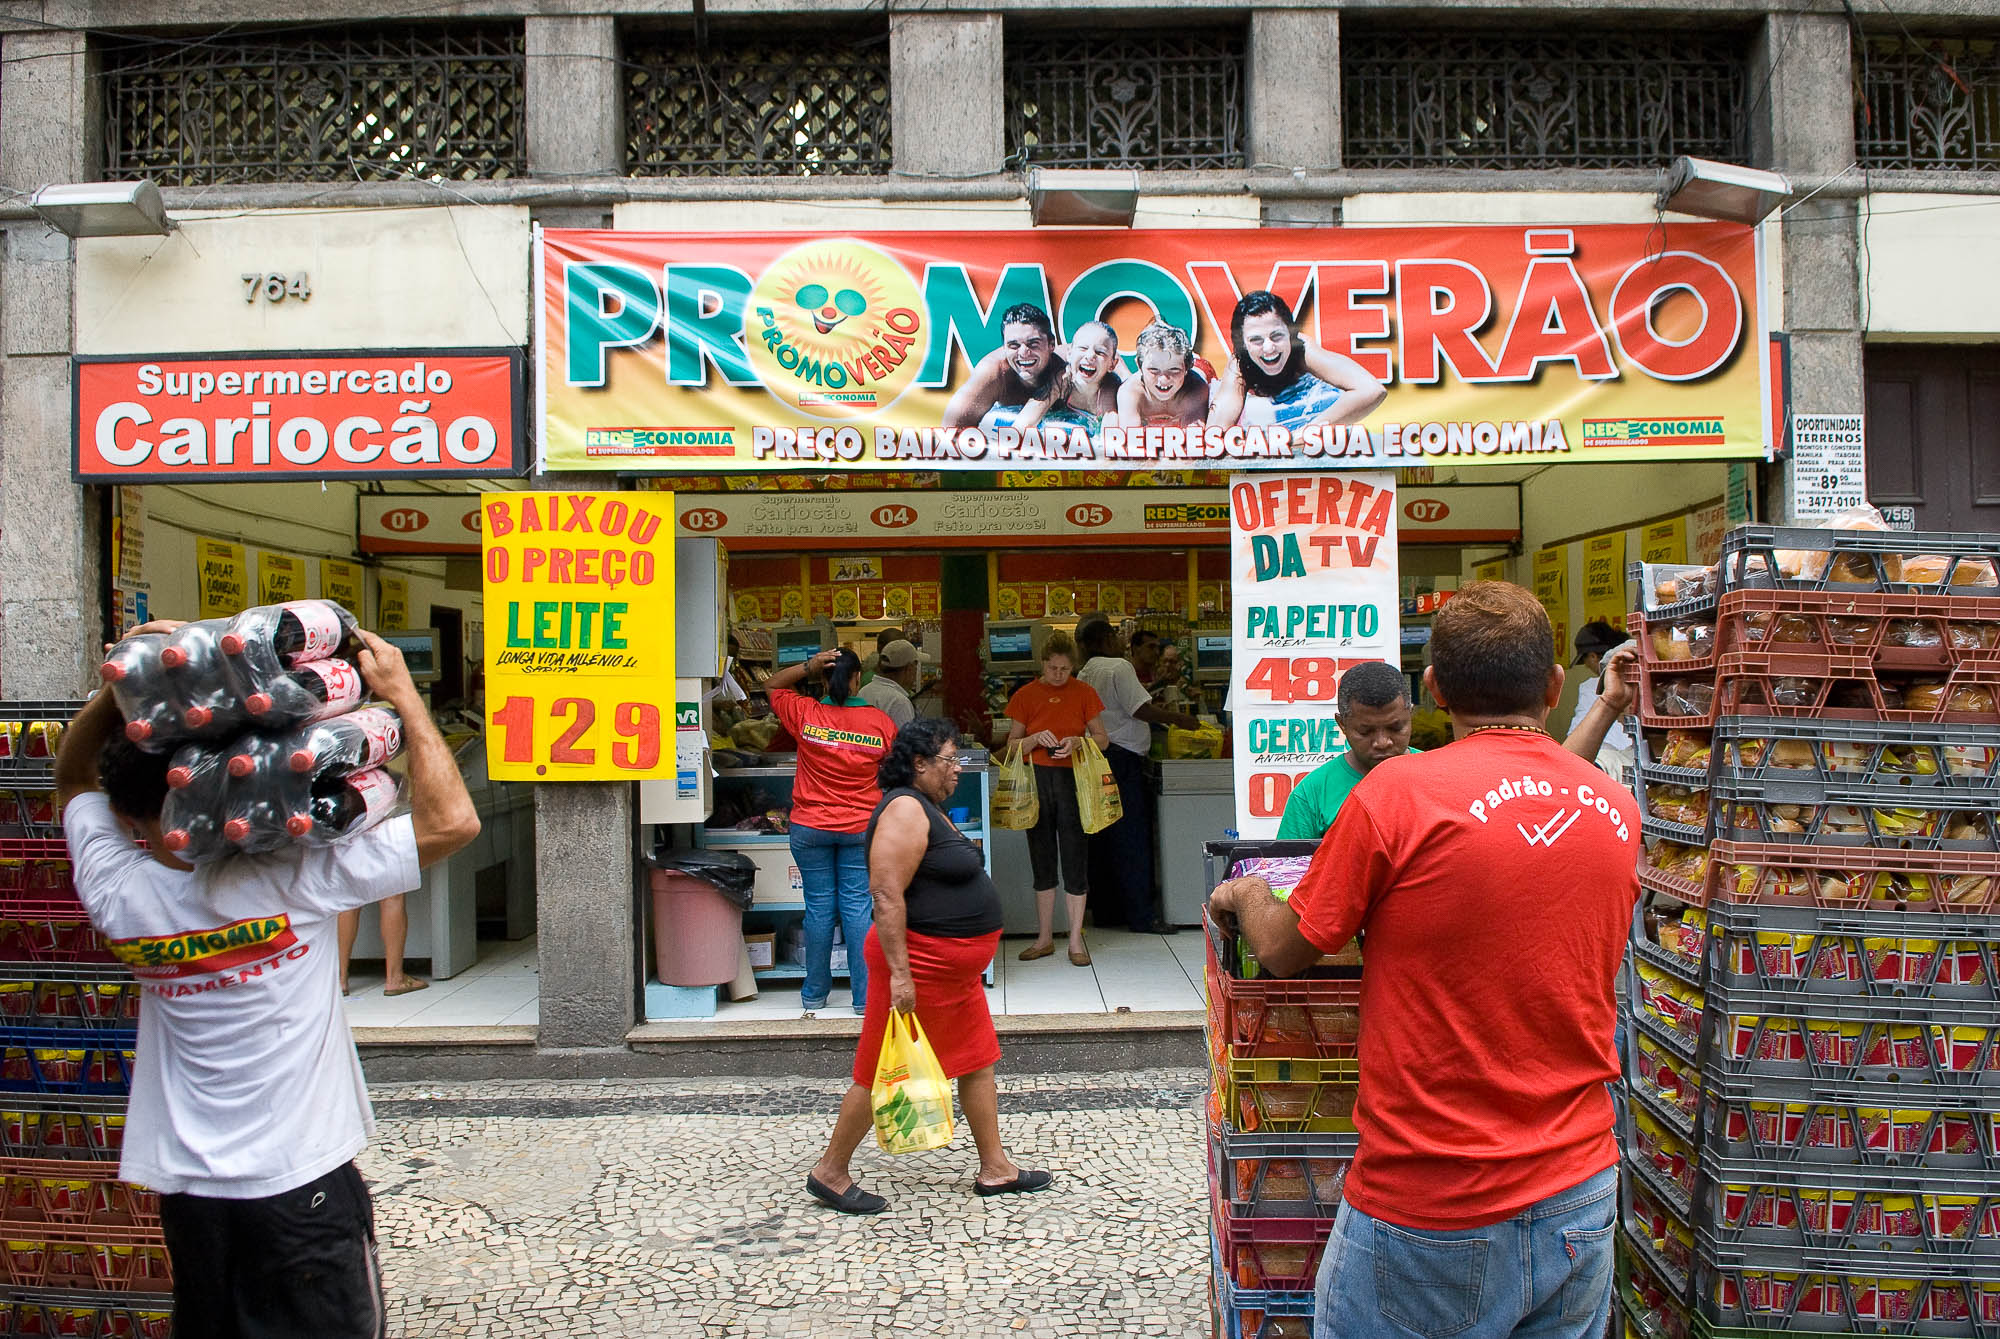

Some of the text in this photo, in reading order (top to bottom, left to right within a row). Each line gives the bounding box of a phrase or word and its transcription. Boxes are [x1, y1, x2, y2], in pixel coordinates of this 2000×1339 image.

[241, 271, 311, 302] 764
[756, 307, 920, 389] PROMOVERÃO
[137, 362, 453, 402] Supermercado
[1796, 418, 1861, 431] OPORTUNIDADE
[94, 400, 498, 467] Cariocão
[752, 419, 1571, 465] PREÇO BAIXO PARA REFRESCAR SUA ECONOMIA
[1797, 434, 1861, 443] TERRENOS
[1821, 475, 1838, 489] 89
[752, 504, 852, 521] Cariocão
[943, 502, 1040, 518] Cariocão
[1074, 507, 1104, 523] 05
[1232, 477, 1393, 537] OFERTA
[1412, 502, 1441, 519] 07
[1883, 509, 1911, 521] 756
[391, 512, 419, 529] 01
[486, 495, 661, 545] BAIXOU
[688, 511, 718, 529] 03
[879, 508, 909, 524] 04
[744, 523, 782, 534] Feito
[787, 524, 813, 535] pra
[935, 520, 972, 532] Feito
[977, 522, 1002, 534] pra
[1251, 533, 1379, 582] DA TV
[487, 547, 655, 591] O PREÇO
[507, 601, 628, 650] LEITE
[496, 651, 535, 666] LONGA
[538, 651, 565, 666] VIDA
[1248, 719, 1352, 753] CERVE
[1469, 776, 1553, 823] Padrão
[1577, 785, 1630, 842] Coop
